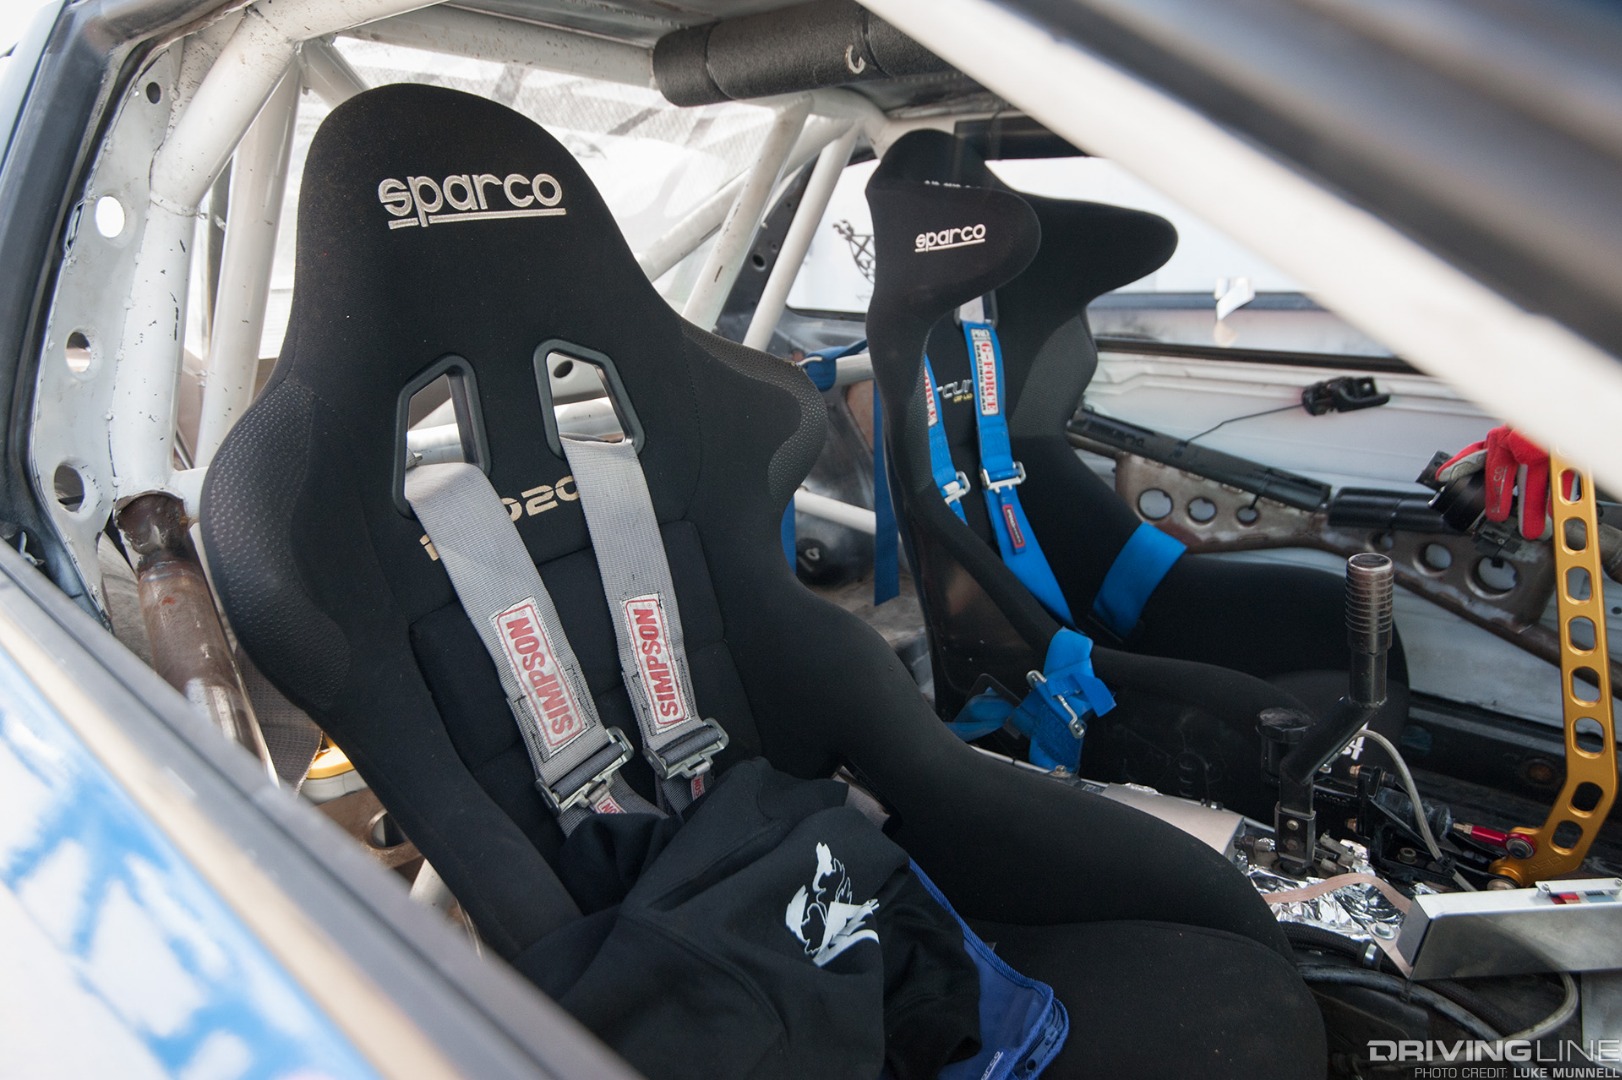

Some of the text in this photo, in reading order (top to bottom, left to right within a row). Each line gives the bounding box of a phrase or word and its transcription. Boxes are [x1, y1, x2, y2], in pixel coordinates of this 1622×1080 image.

[378, 173, 565, 229] sparco
[915, 223, 986, 252] sparco
[981, 342, 997, 411] G-FORCE
[505, 616, 574, 737] SIMPSON
[633, 608, 679, 718] SIMPSON
